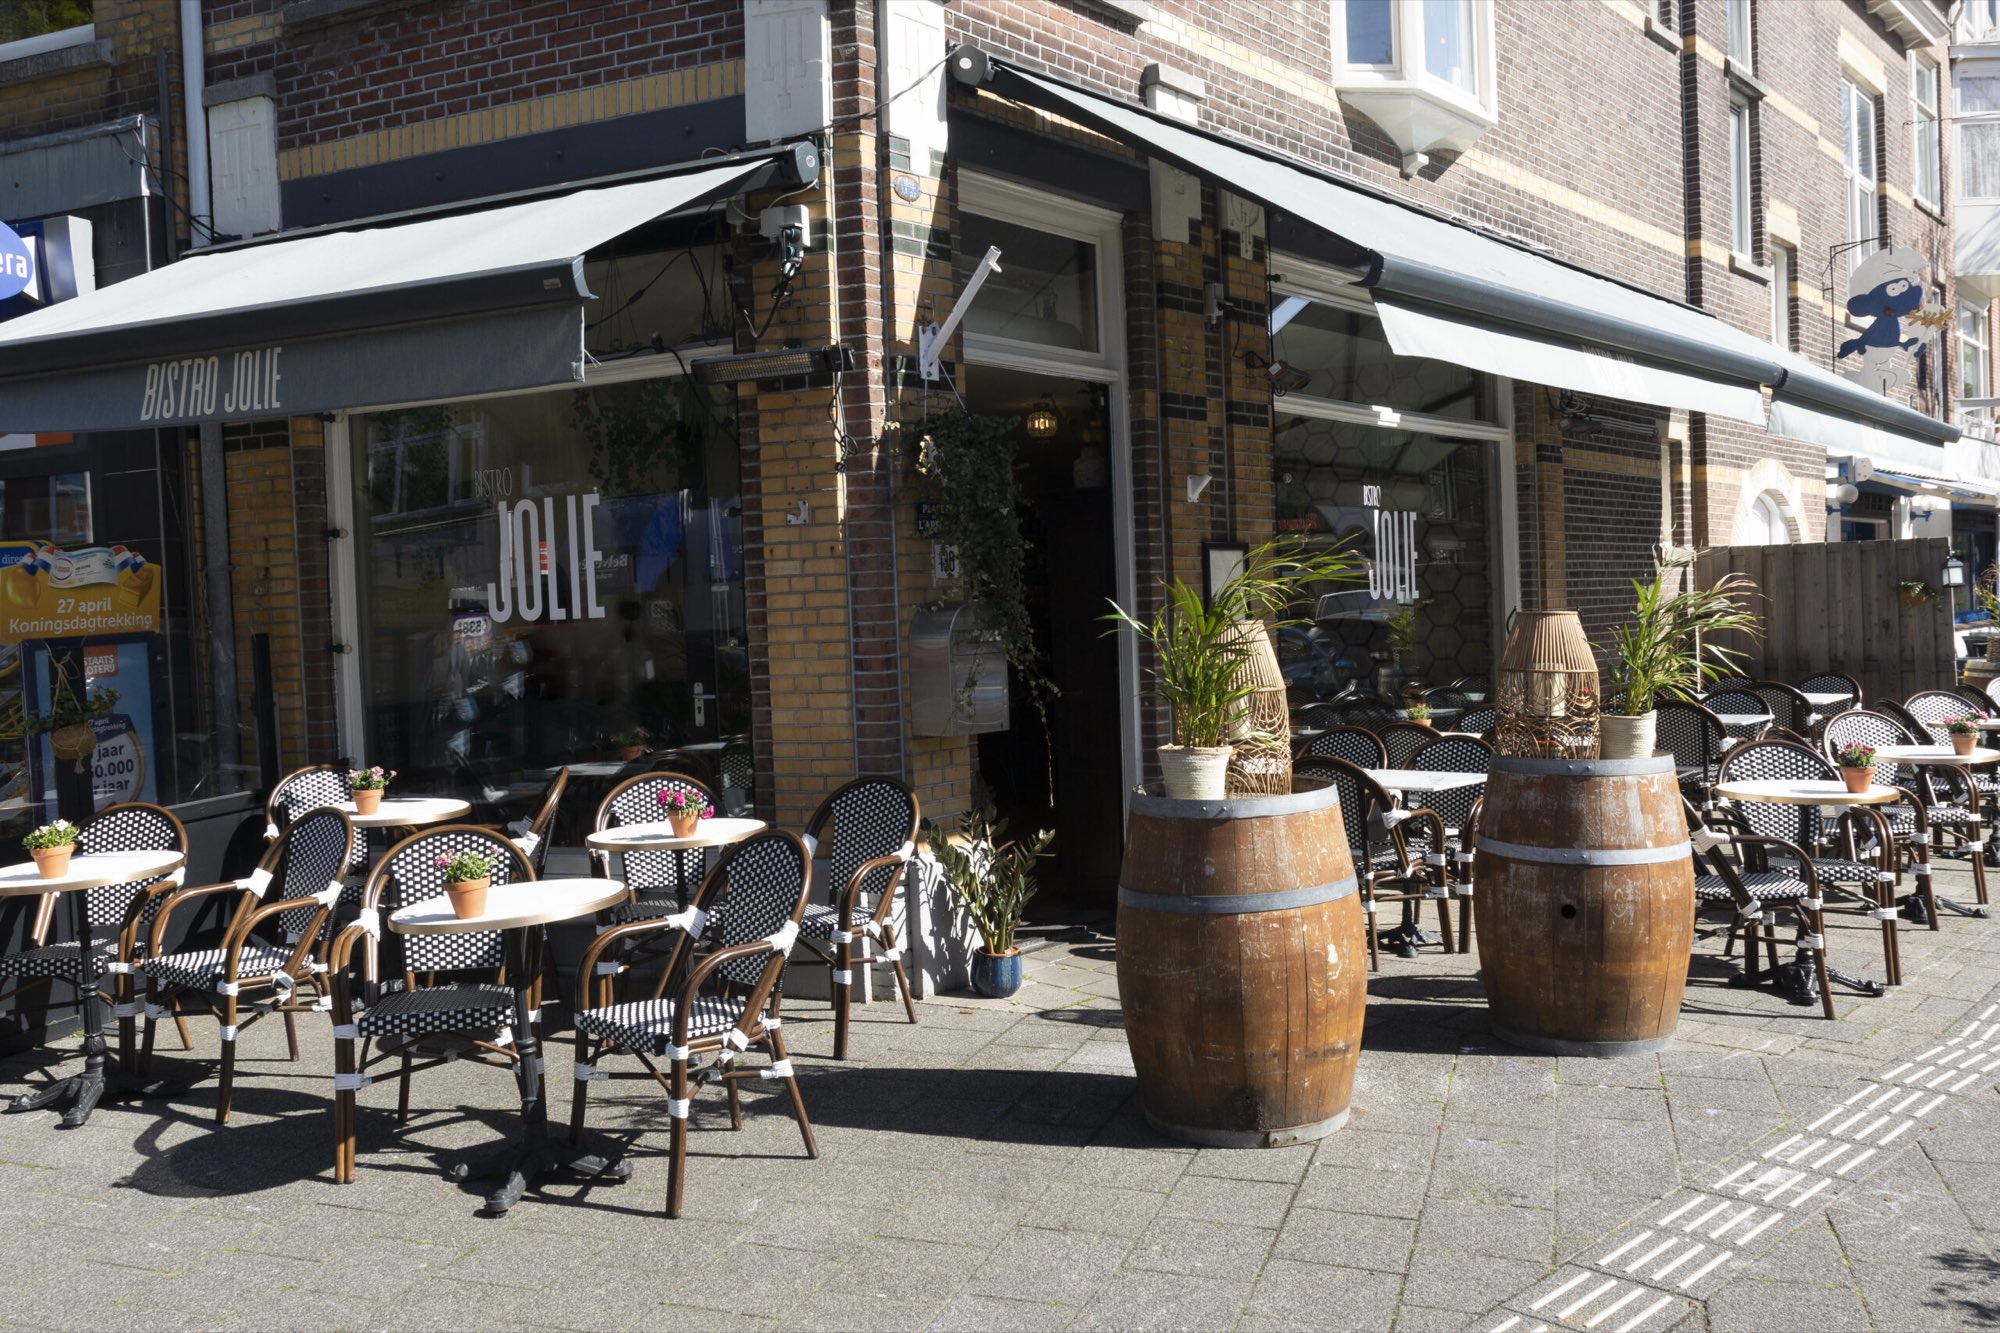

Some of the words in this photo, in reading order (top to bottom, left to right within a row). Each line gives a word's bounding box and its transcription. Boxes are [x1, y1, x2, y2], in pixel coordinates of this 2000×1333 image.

[140, 356, 219, 421] BISTRO
[224, 347, 282, 413] JOLIE
[474, 467, 513, 498] BISTRO
[1363, 484, 1382, 508] BISTRO
[487, 493, 606, 623] JOLIE
[1368, 509, 1420, 601] JOLIE
[56, 598, 76, 614] 27
[78, 596, 112, 615] april
[9, 612, 153, 635] Koningsdagtrekking
[86, 663, 115, 675] OTERIJ
[96, 744, 125, 762] jaar
[103, 779, 130, 795] jaar
